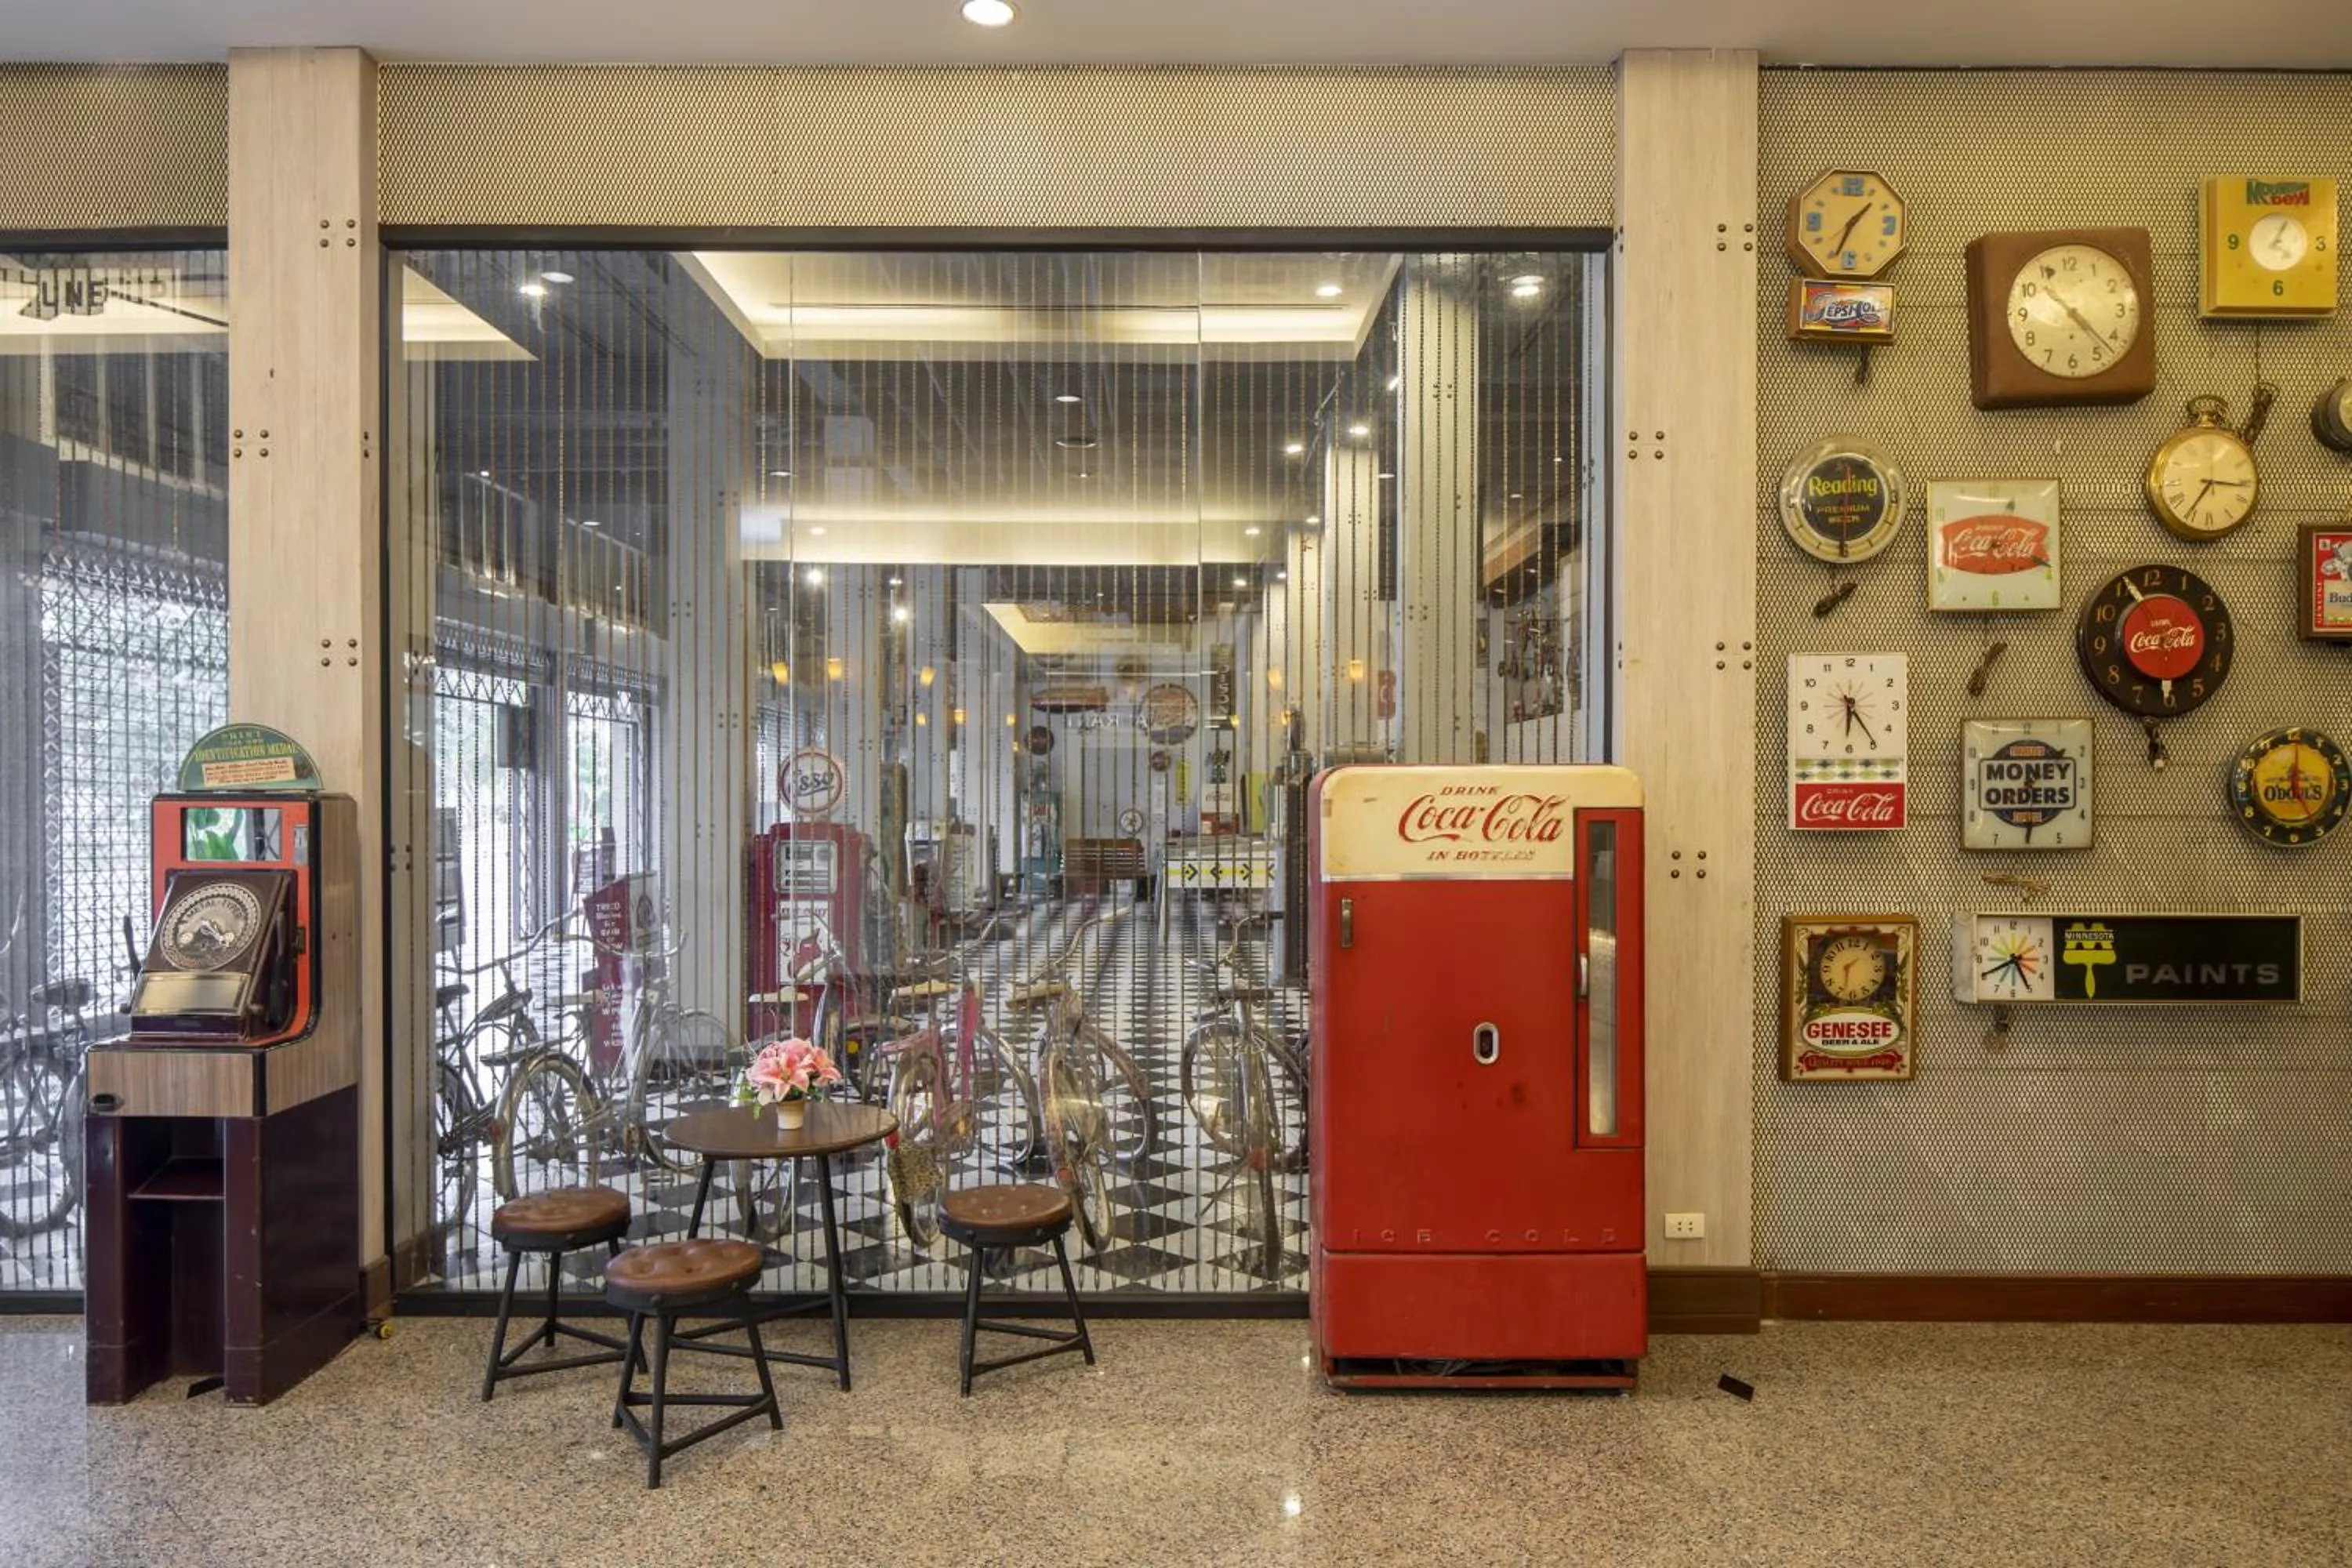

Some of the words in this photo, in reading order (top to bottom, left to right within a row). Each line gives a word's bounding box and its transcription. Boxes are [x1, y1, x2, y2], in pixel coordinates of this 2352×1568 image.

[2227, 233, 2239, 250] 9
[2315, 235, 2326, 251] 3
[2062, 256, 2077, 271] 12
[2090, 263, 2096, 276] 1
[2022, 282, 2036, 298] 10
[2107, 278, 2117, 293] 2
[2273, 279, 2283, 296] 6
[2017, 307, 2027, 321] 9
[2115, 303, 2125, 318] 3
[2026, 331, 2035, 347] 8
[2108, 329, 2118, 339] 4
[2044, 349, 2053, 363] 7
[2092, 346, 2102, 361] 5
[2067, 354, 2078, 368] 6
[1809, 475, 1877, 496] Reading
[2143, 570, 2161, 587] 12
[2182, 575, 2187, 590] 1
[2202, 595, 2215, 612] 2
[2096, 604, 2115, 623] 10
[2216, 622, 2226, 641] 3
[2094, 636, 2107, 655] 9
[1846, 659, 1856, 667] 12
[2211, 652, 2222, 672] 4
[2107, 665, 2120, 684] 8
[1805, 679, 1817, 688] 10
[1886, 678, 1893, 688] 2
[2193, 679, 2204, 697] 5
[2132, 686, 2143, 704] 7
[1801, 702, 1808, 710] 9
[1892, 702, 1899, 710] 3
[1806, 724, 1814, 734] 8
[1885, 724, 1892, 733] 4
[1822, 741, 1829, 750] 7
[1846, 745, 1853, 753] 6
[2333, 754, 2342, 764] 2
[1986, 763, 2071, 781] MONEY
[1439, 786, 1502, 796] DRINK
[2339, 780, 2349, 790] 3
[1985, 787, 2070, 804] ORDERS
[1802, 793, 1897, 822] Coca-Cola
[2245, 806, 2254, 818] 8
[2334, 806, 2342, 816] 4
[1398, 794, 1570, 843] Coca-Cola
[2056, 832, 2063, 844] 5
[2263, 826, 2271, 837] 7
[1993, 834, 1998, 845] 7
[1426, 851, 1450, 861] IN
[1994, 925, 2000, 934] 11
[2009, 920, 2017, 929] 12
[2038, 938, 2044, 947] 2
[2064, 931, 2114, 941] MINNESOTA
[2043, 955, 2049, 964] 3
[2125, 964, 2280, 984] PAINTS
[1994, 985, 1999, 993] 7
[1806, 1022, 1892, 1039] GENESEE
[1353, 1229, 1432, 1245] ICE
[1485, 1229, 1617, 1244] COLD
